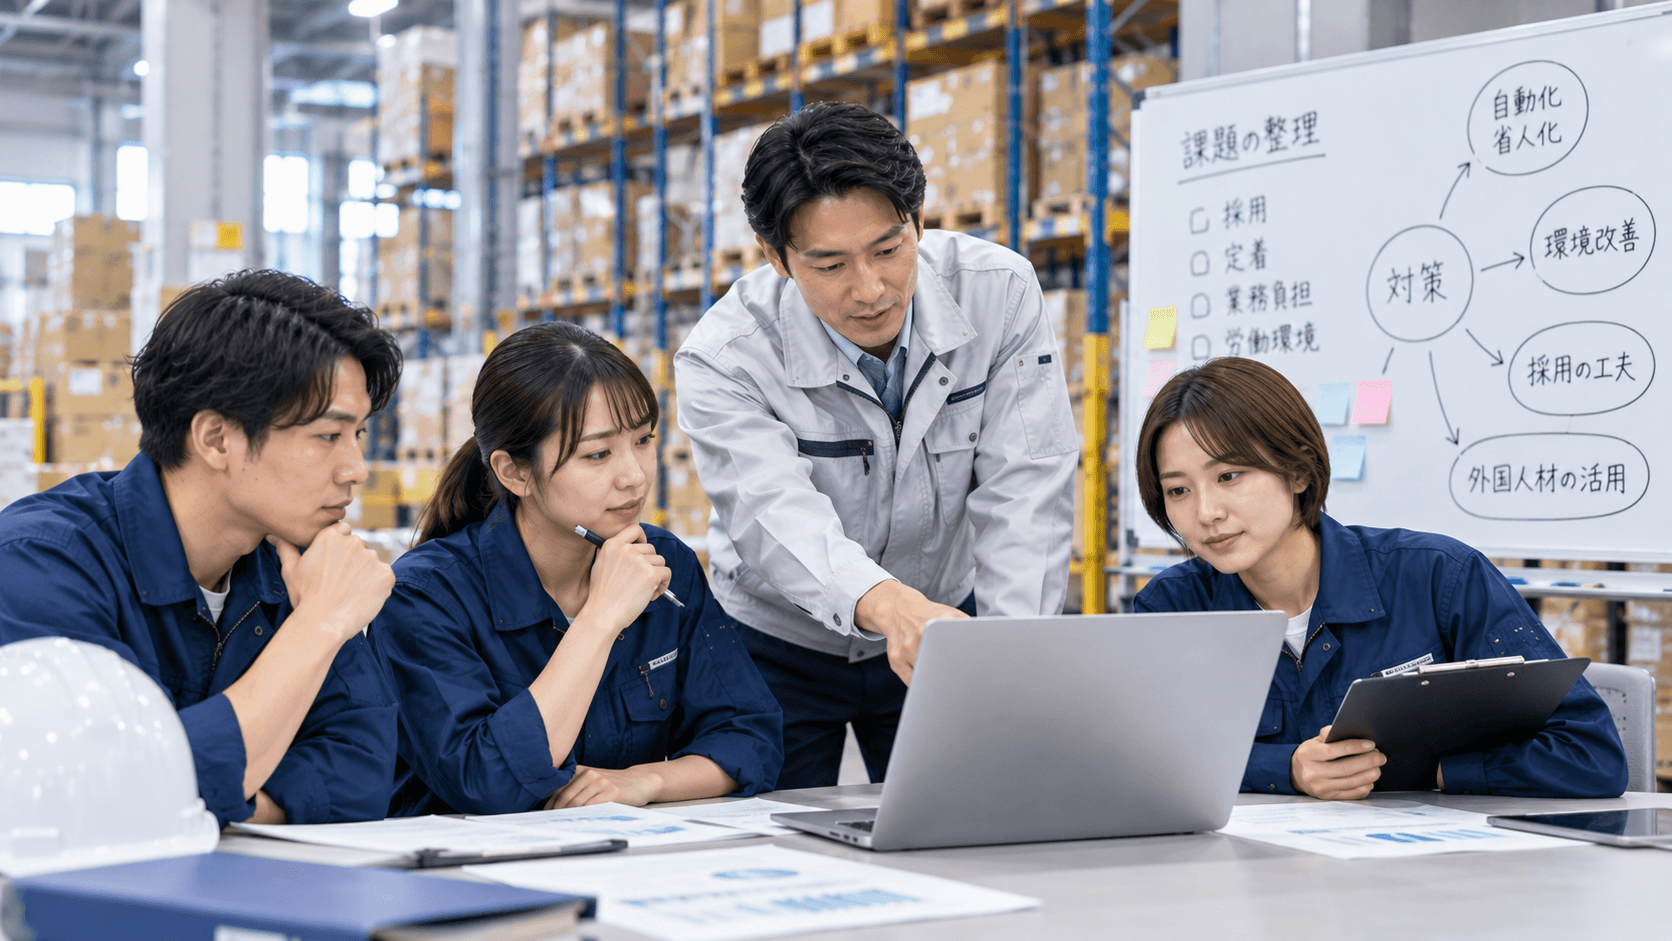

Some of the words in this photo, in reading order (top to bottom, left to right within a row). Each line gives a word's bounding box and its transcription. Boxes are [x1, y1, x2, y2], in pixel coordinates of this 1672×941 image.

[1493, 85, 1562, 121] 自動化
[1180, 110, 1320, 170] 課題の整理
[1493, 121, 1562, 155] 省人化
[1223, 195, 1267, 230] 採用
[1224, 236, 1267, 273] 定着
[1543, 217, 1640, 260] 環境改善
[1225, 280, 1313, 315] 業務負担
[1387, 260, 1447, 304] 対策
[1225, 321, 1320, 356] 労働環境
[1527, 351, 1636, 387] 採用の工夫
[1468, 463, 1626, 494] 外国人材の活用
